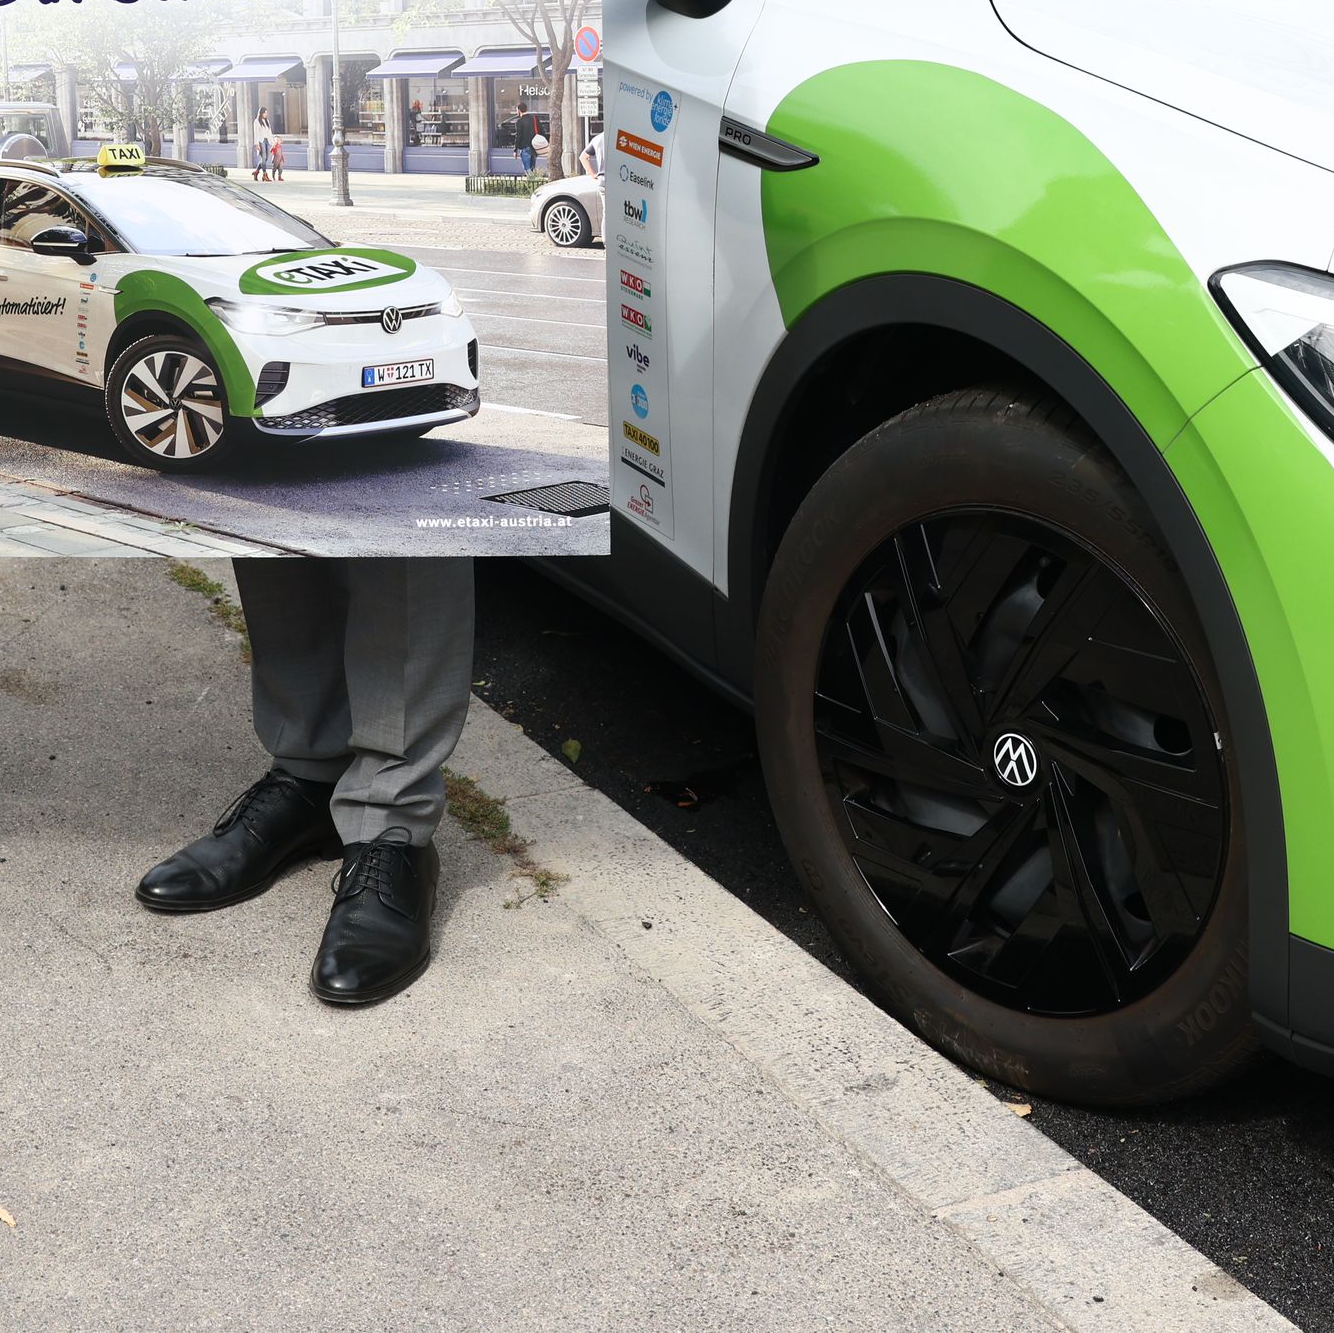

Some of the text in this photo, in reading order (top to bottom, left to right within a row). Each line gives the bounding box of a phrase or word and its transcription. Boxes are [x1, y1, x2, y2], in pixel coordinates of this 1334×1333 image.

[618, 81, 645, 99] powered
[646, 88, 655, 104] by
[724, 126, 752, 146] PRO
[108, 148, 141, 160] TAXI
[628, 140, 662, 160] WIEN ENERGIE
[629, 171, 655, 190] Easelink
[624, 199, 643, 222] tbw
[620, 270, 643, 293] WKO
[621, 305, 644, 327] WKO
[626, 343, 650, 368] vibe
[377, 368, 385, 382] W
[395, 364, 416, 380] 121
[418, 362, 432, 377] TX
[623, 423, 660, 453] TAXI 40100
[624, 448, 664, 479] ENERGIE GRAZ
[415, 515, 573, 528] www.etaxi-austria.at
